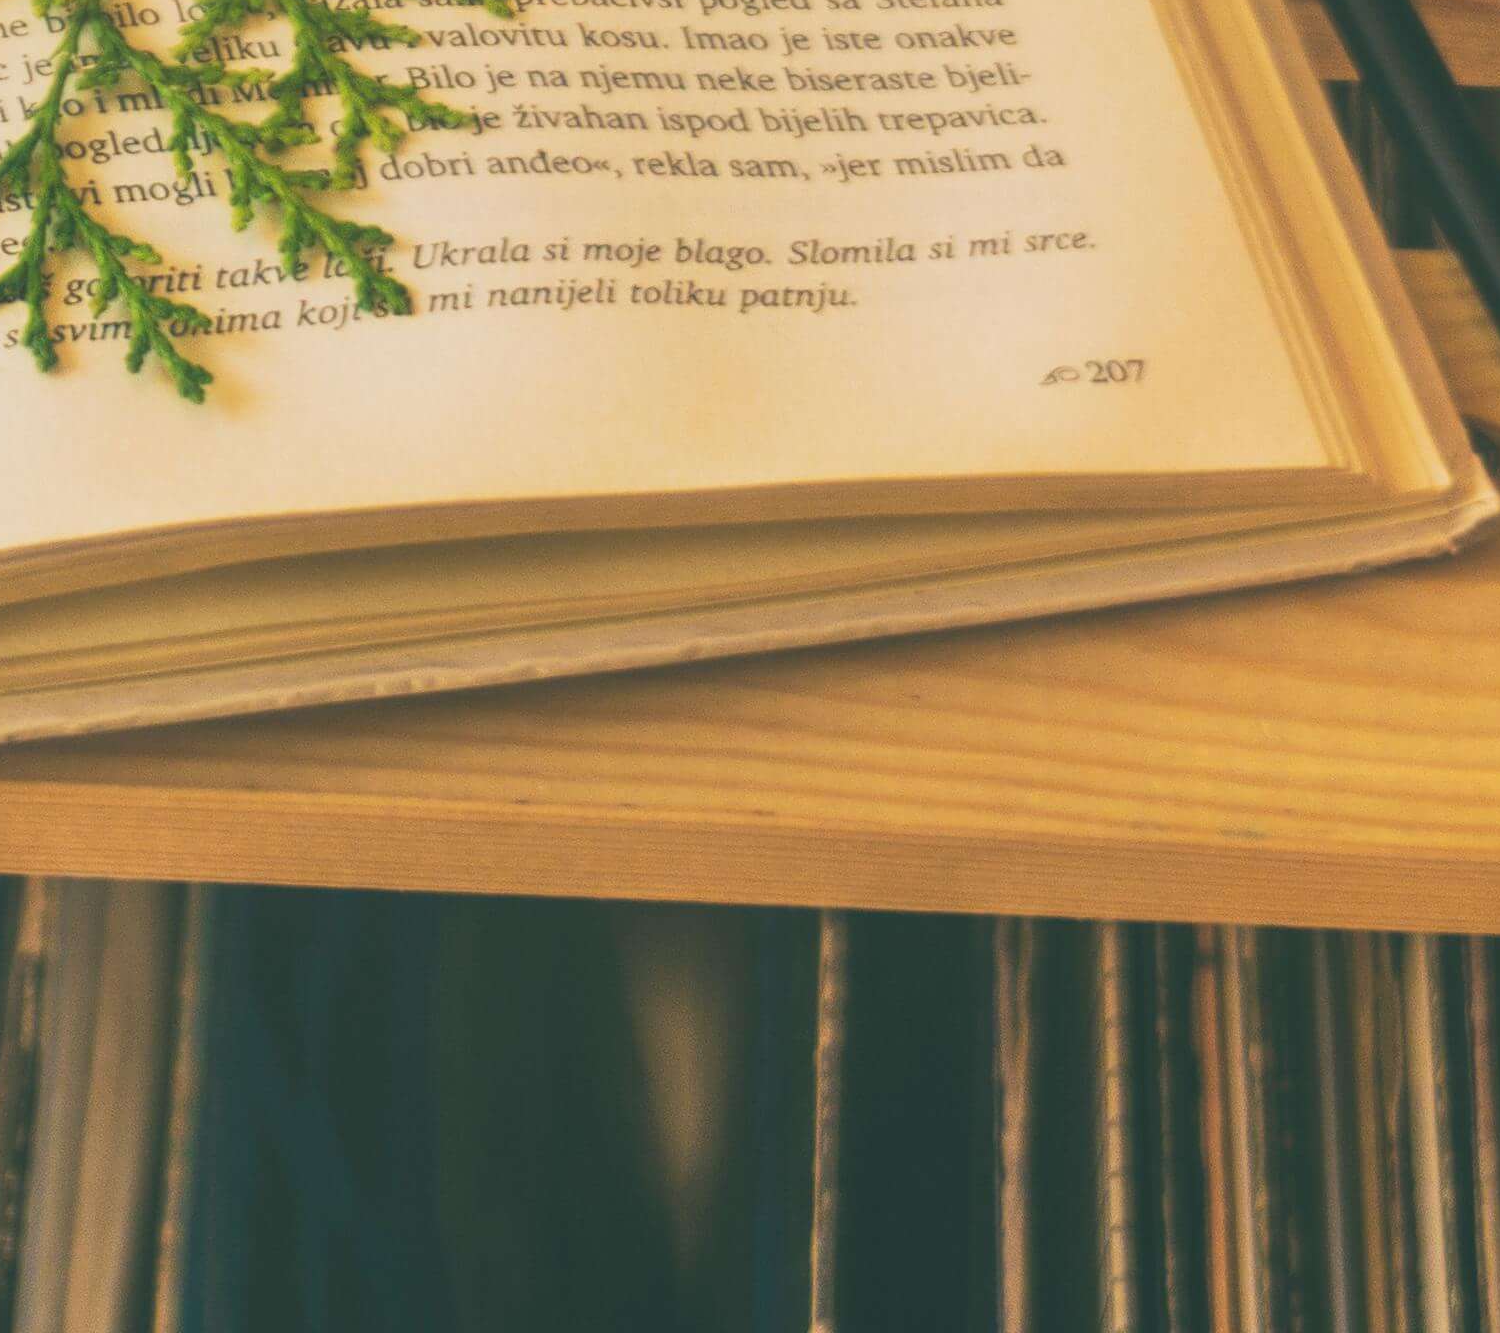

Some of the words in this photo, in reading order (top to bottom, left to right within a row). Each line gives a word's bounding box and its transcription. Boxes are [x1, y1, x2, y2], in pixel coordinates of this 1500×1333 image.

[408, 63, 476, 92] Bilo
[488, 70, 515, 94] je
[527, 70, 570, 88] na
[579, 70, 687, 94] njemu
[696, 67, 776, 92] neke
[784, 68, 936, 92] biseraste
[943, 63, 1031, 93] bjeli-
[513, 104, 649, 130] živahan
[659, 108, 751, 139] ispod
[758, 108, 869, 138] bijelih
[878, 107, 1048, 136] trepavica.
[380, 146, 475, 181] dobri
[487, 149, 623, 179] anđeo«,
[632, 151, 720, 178] rekla
[729, 159, 811, 181] sam,
[822, 158, 881, 184] »jer
[893, 149, 1012, 176] mislim
[1022, 144, 1068, 168] da
[413, 237, 531, 270] Ukrala
[543, 237, 569, 262] si
[584, 238, 662, 268] moje
[675, 237, 772, 272] blago.
[788, 237, 917, 265] Slomila
[928, 242, 956, 260] si
[969, 230, 1012, 258] mi
[1024, 231, 1098, 253] srce.
[428, 291, 473, 313] mi
[487, 278, 616, 311] nanijeli
[630, 279, 727, 307] toliku
[740, 282, 858, 315] patnju.
[1078, 358, 1148, 386] 207
